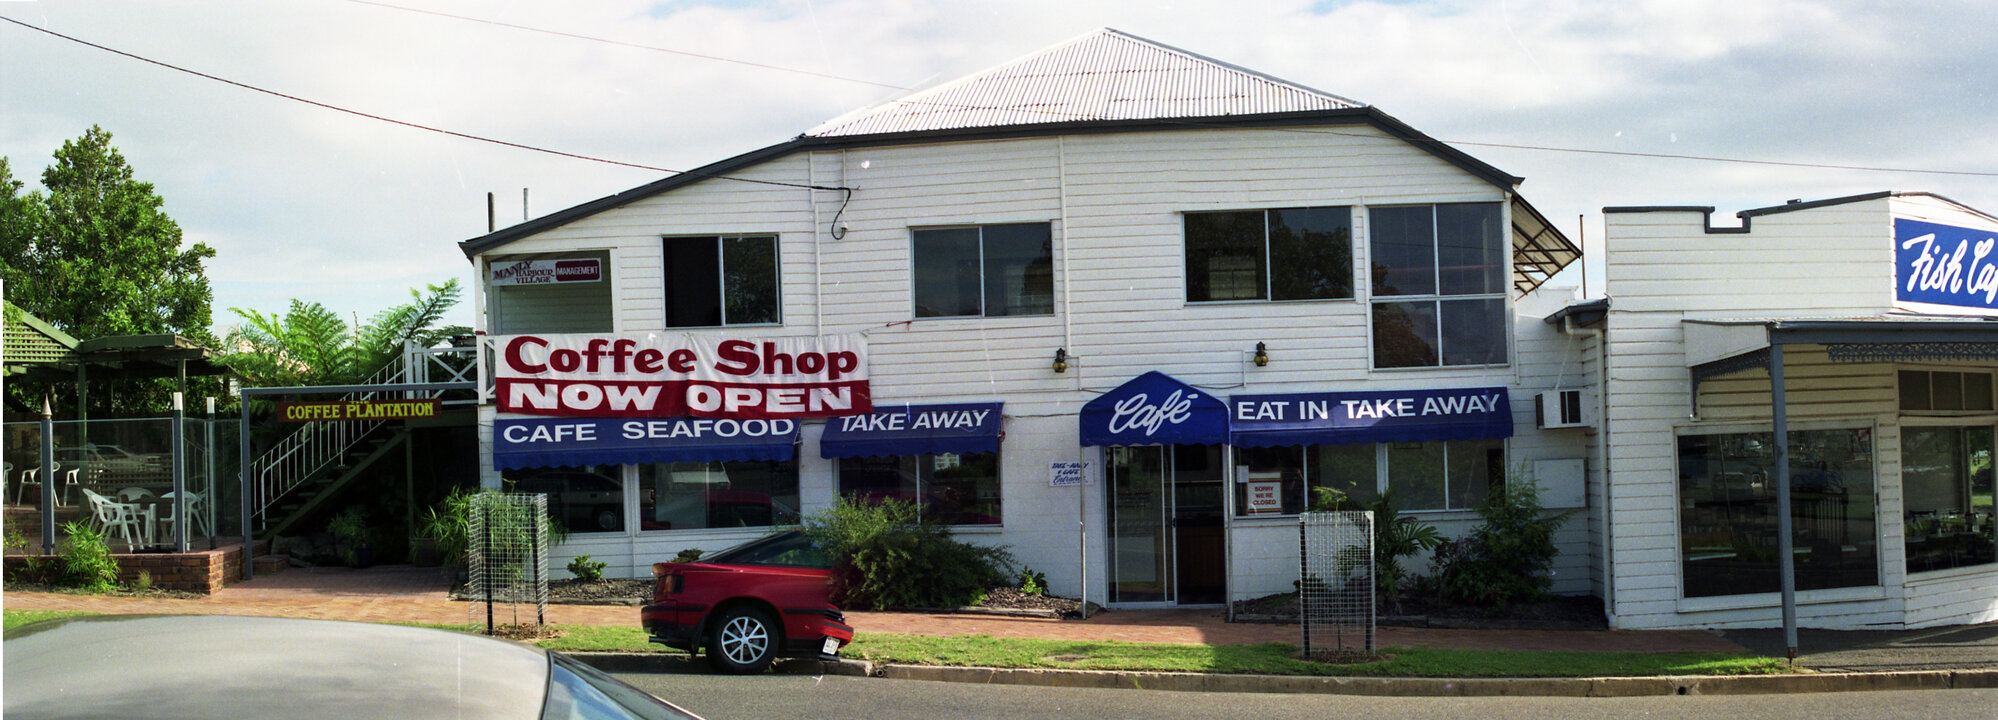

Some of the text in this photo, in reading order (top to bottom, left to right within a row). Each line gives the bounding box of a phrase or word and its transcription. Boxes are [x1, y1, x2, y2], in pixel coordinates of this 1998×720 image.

[494, 261, 532, 279] MANLY
[516, 268, 555, 277] HARBOUR
[556, 265, 598, 275] MANAGEMENT
[1902, 233, 1968, 294] Fish
[515, 276, 551, 284] VILLAGE
[504, 336, 859, 380] Coffee Shop
[508, 382, 854, 413] NOW OPEN
[1237, 394, 1500, 421] EAT IN TAKE AWAY
[286, 402, 434, 420] COFFEE PLANTATION
[839, 408, 991, 432] TAKE AWAY
[1109, 389, 1198, 436] Café
[503, 418, 795, 443] CAFE SEAFOOD
[1053, 475, 1088, 484] Entrane
